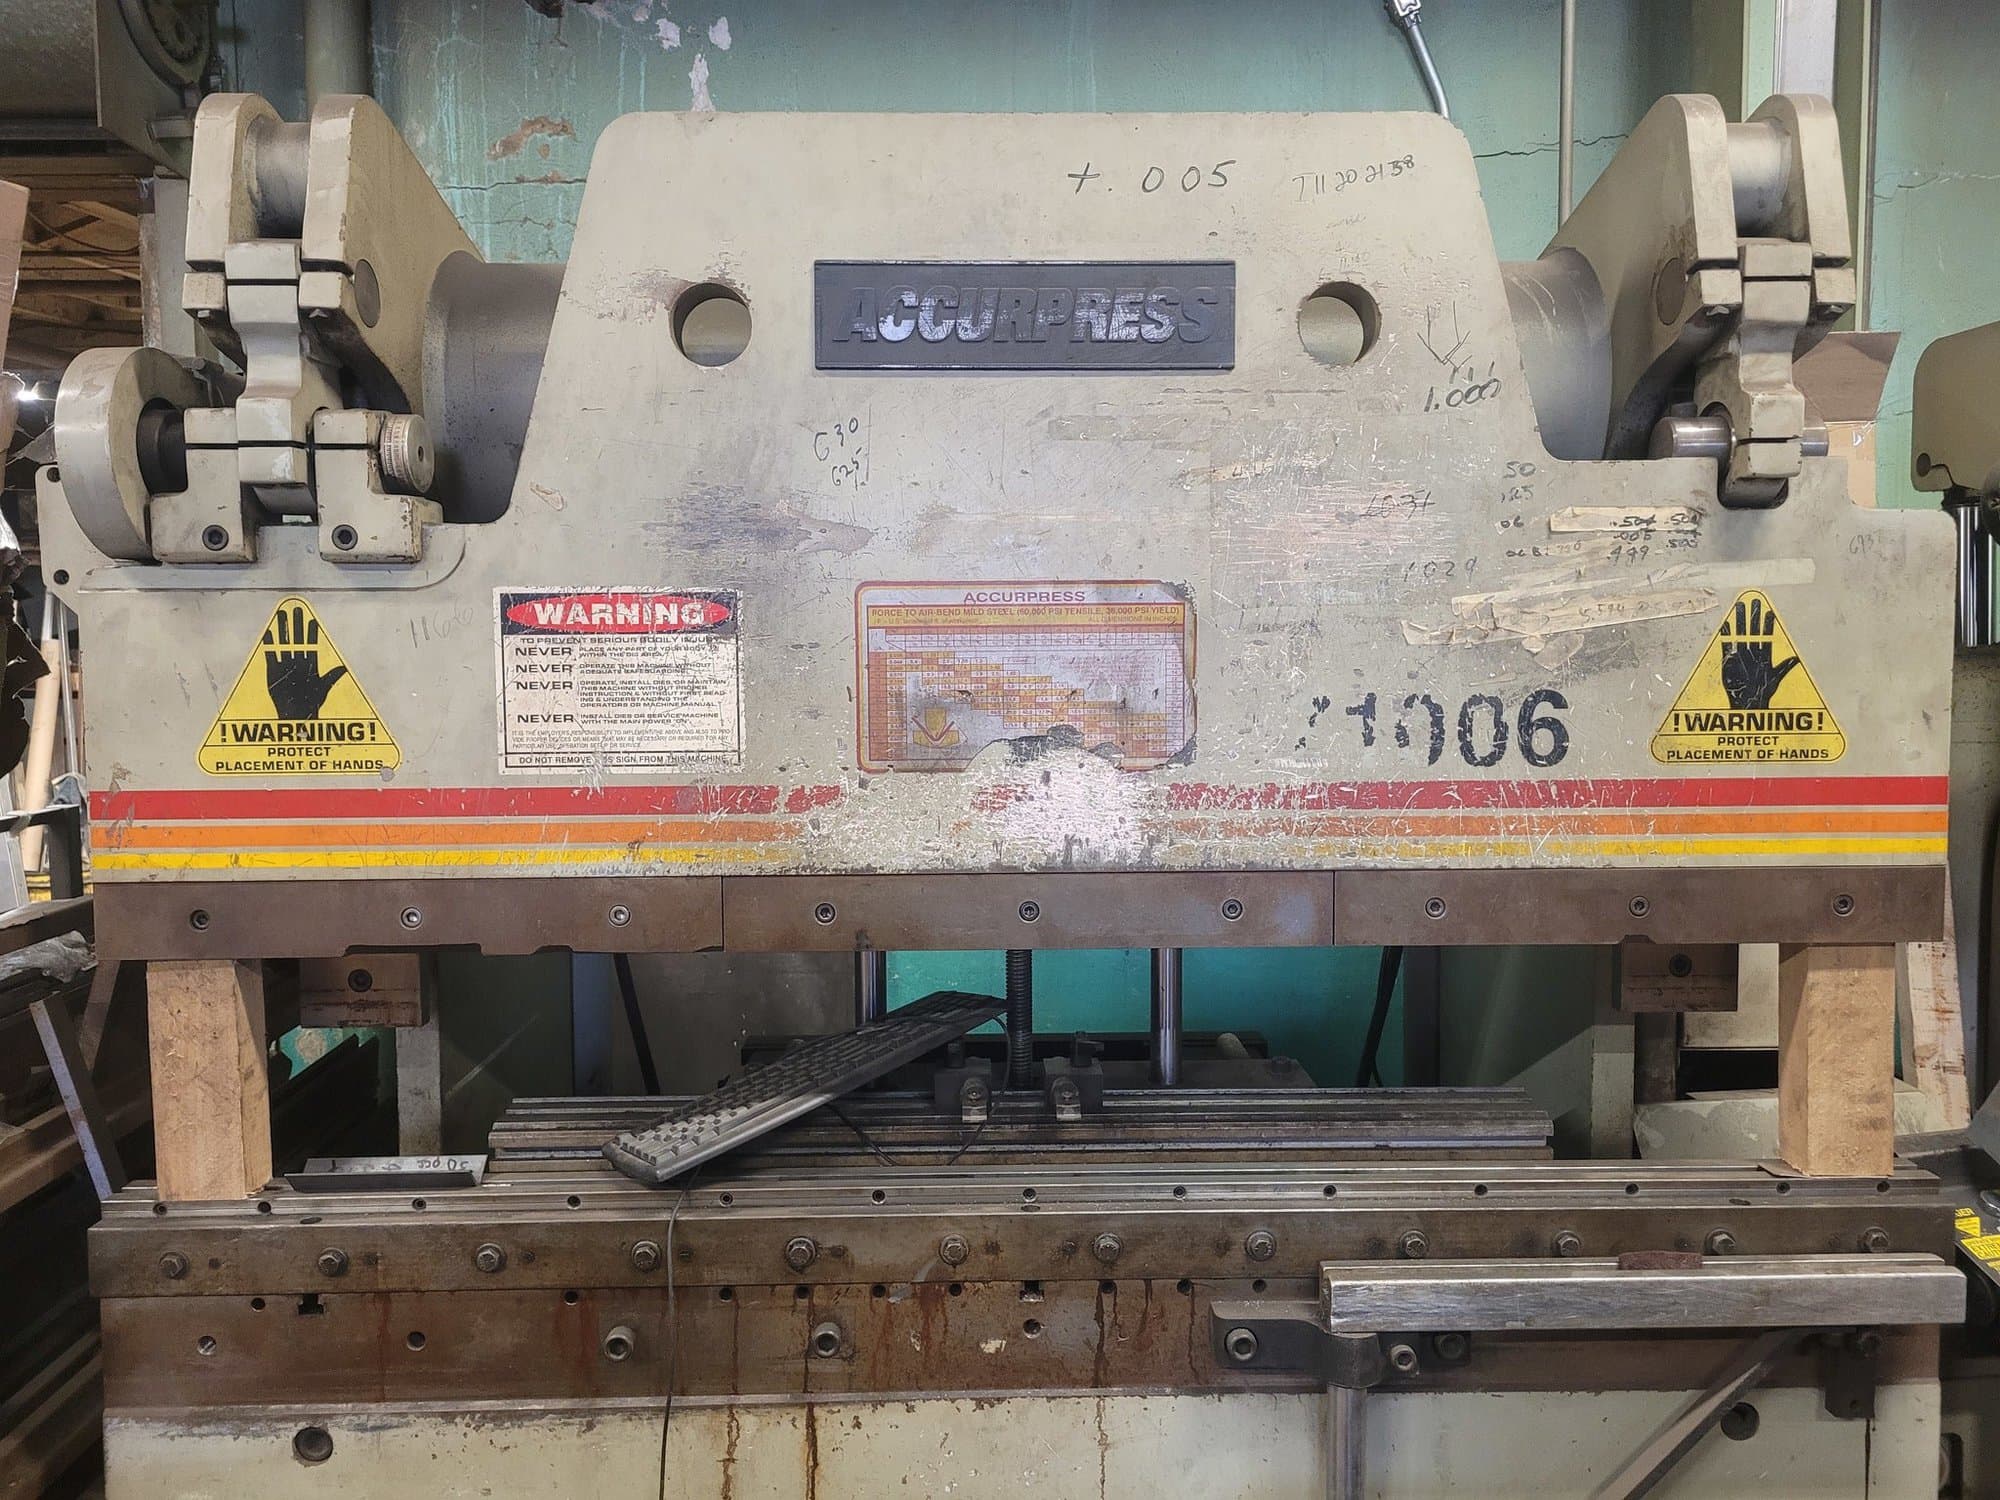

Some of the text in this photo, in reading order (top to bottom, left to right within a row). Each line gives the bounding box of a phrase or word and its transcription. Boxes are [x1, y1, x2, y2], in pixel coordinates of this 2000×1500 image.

[832, 286, 1219, 343] ACCURPRESS
[964, 591, 1086, 604] ACCURPRESS
[533, 603, 706, 626] WARNING
[872, 609, 901, 617] FORCE
[918, 608, 961, 616] AIR-BEND
[963, 607, 984, 616] MILD
[986, 608, 1015, 616] STEEL
[1152, 606, 1180, 614] YIELD)
[515, 647, 572, 656] NEVER
[516, 664, 573, 673] NEVER
[517, 681, 573, 690] NEVER
[517, 715, 575, 724] NEVER
[1717, 736, 1779, 746] PROTECT
[267, 747, 331, 757] PROTECT
[1667, 749, 1829, 760] PLACEMENT OF HANDS
[556, 756, 592, 764] REMOVE
[667, 755, 686, 763] THIS
[216, 760, 383, 771] PLACEMENT OF HANDS
